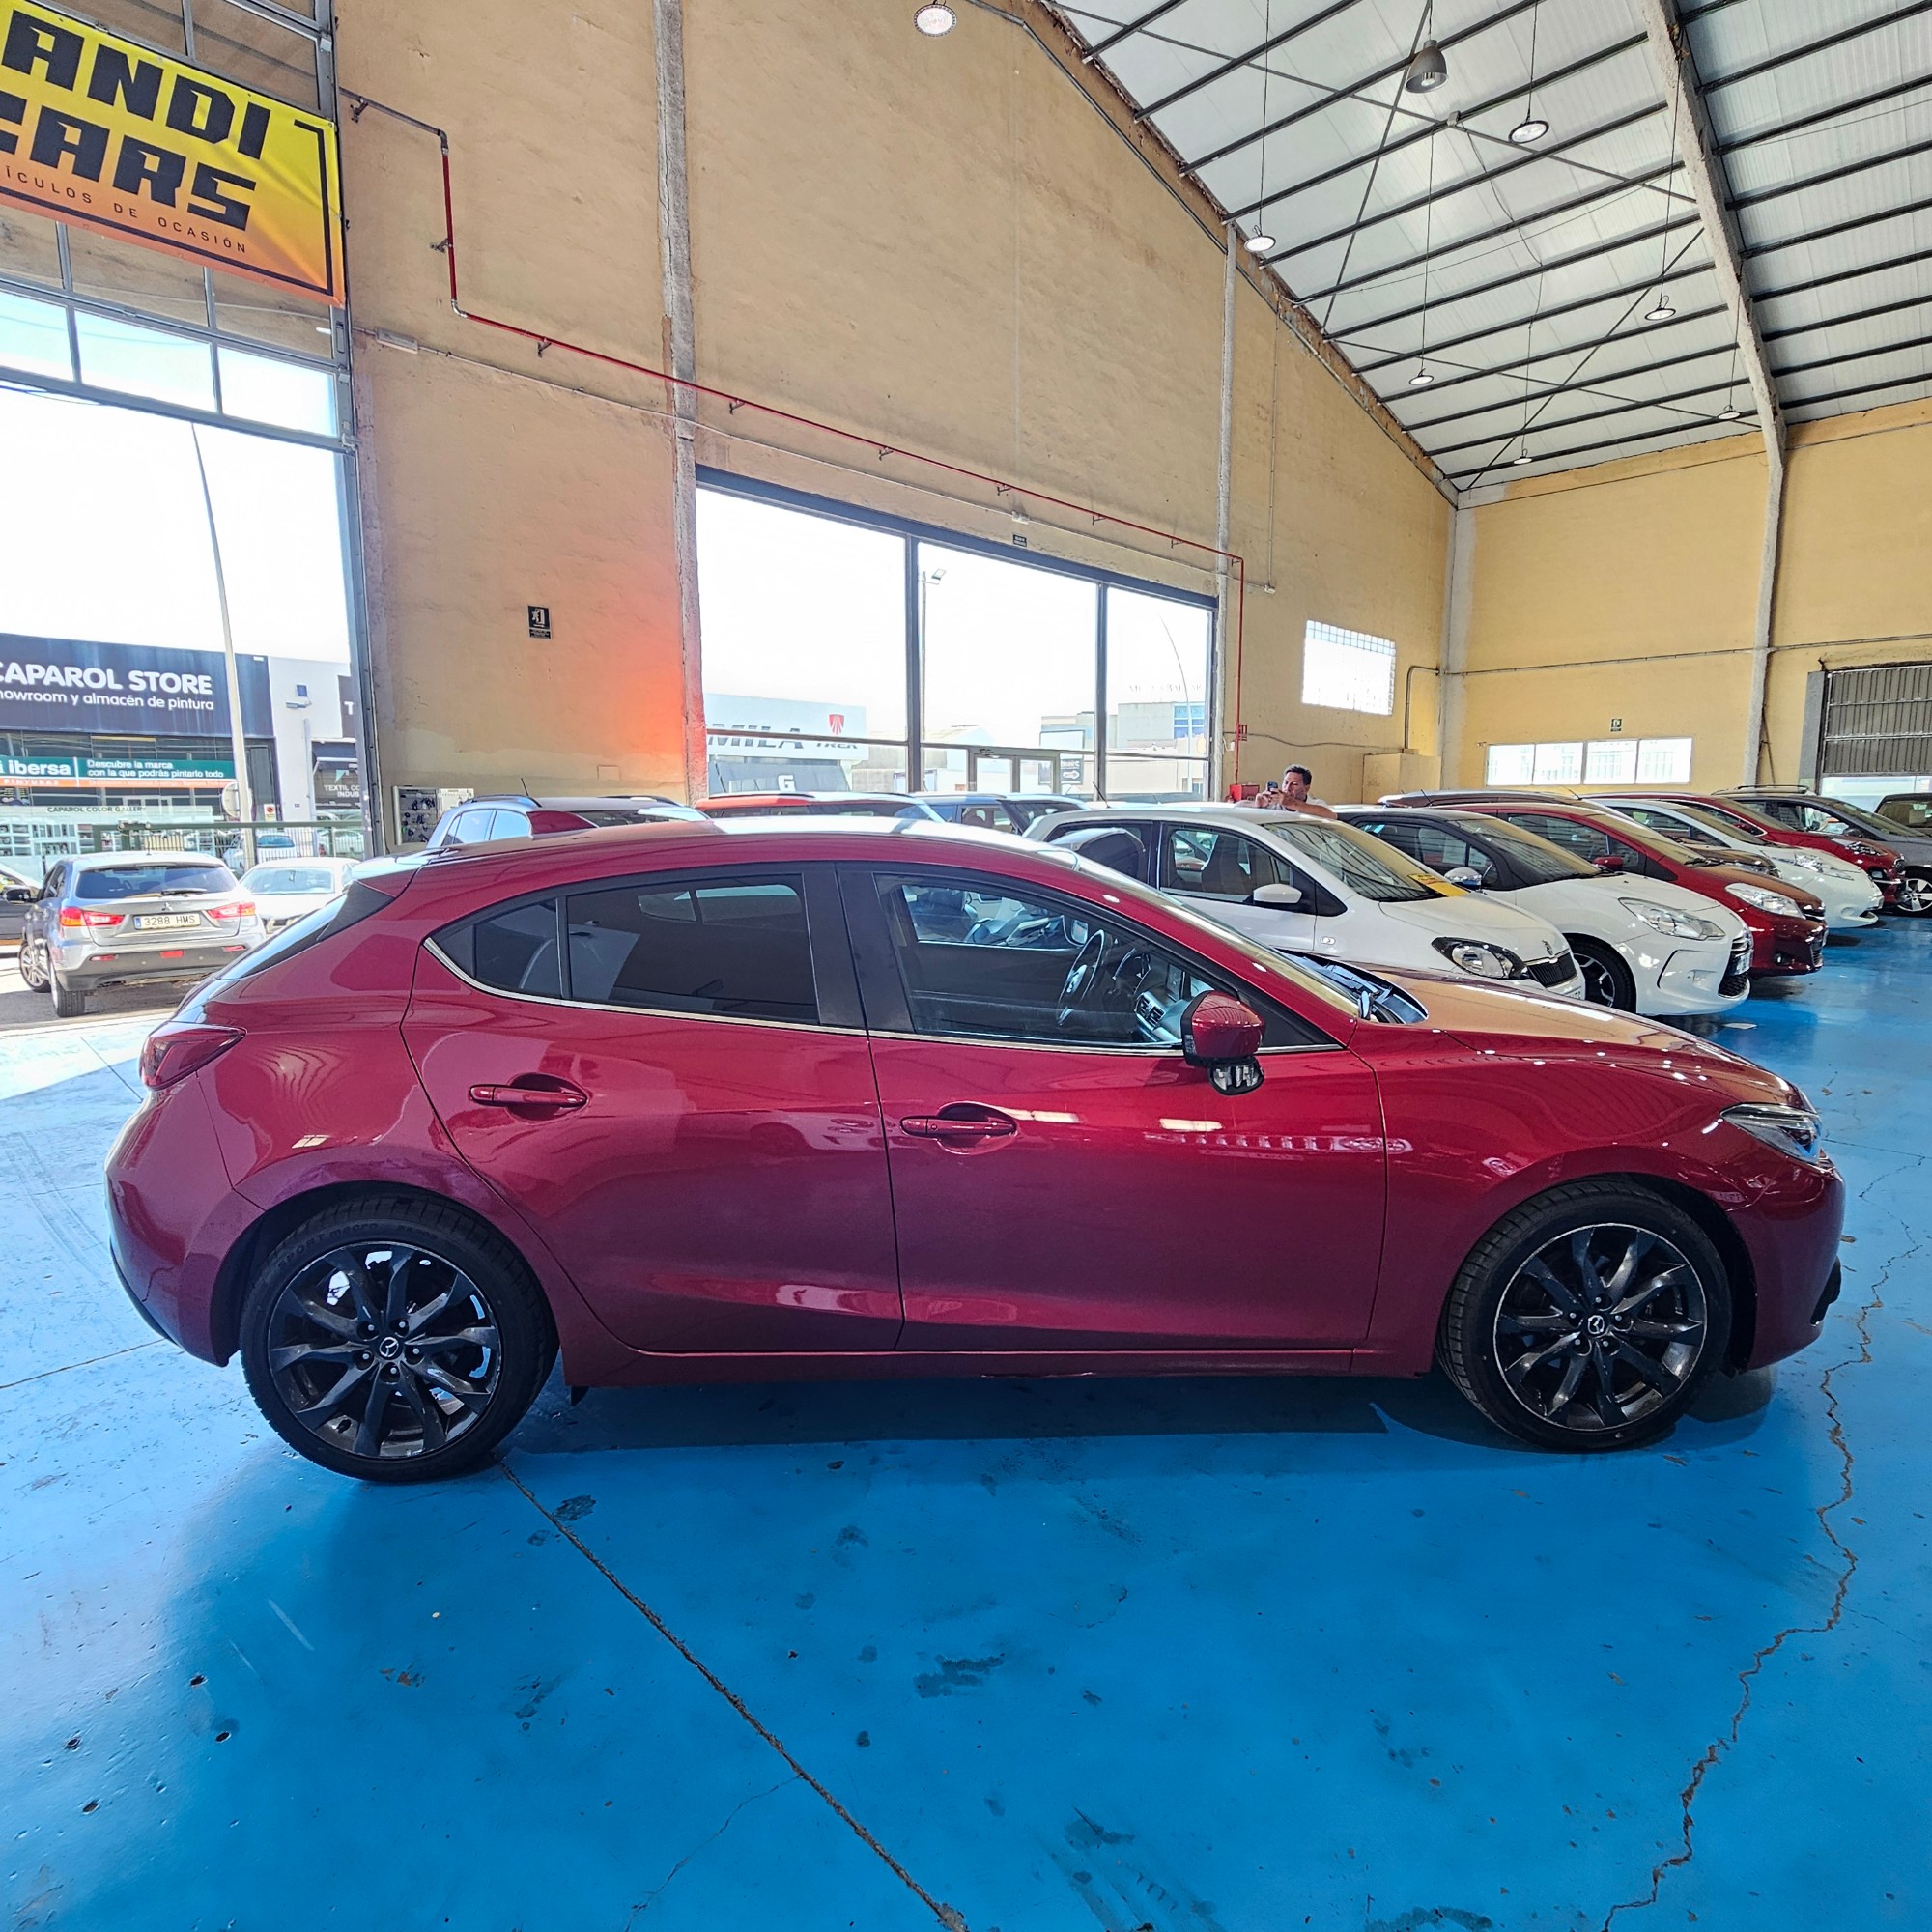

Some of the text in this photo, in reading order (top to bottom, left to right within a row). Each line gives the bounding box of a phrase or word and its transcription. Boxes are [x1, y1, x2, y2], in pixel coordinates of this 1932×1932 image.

[1, 9, 271, 160] ANDI
[113, 202, 138, 218] DE
[157, 216, 245, 253] OCASIÓN
[0, 661, 213, 695] APAROL STORE
[70, 694, 79, 706] y
[83, 692, 144, 707] almacén
[147, 696, 165, 708] de
[168, 696, 214, 711] pintura
[8, 759, 71, 776] ibersa
[86, 758, 132, 769] Descubre
[133, 759, 143, 769] la
[4, 778, 59, 786] PINTURAS
[118, 769, 136, 778] que
[138, 769, 169, 778] podrás
[171, 769, 203, 779] pintarlo
[143, 915, 195, 926] 3288 HMS
